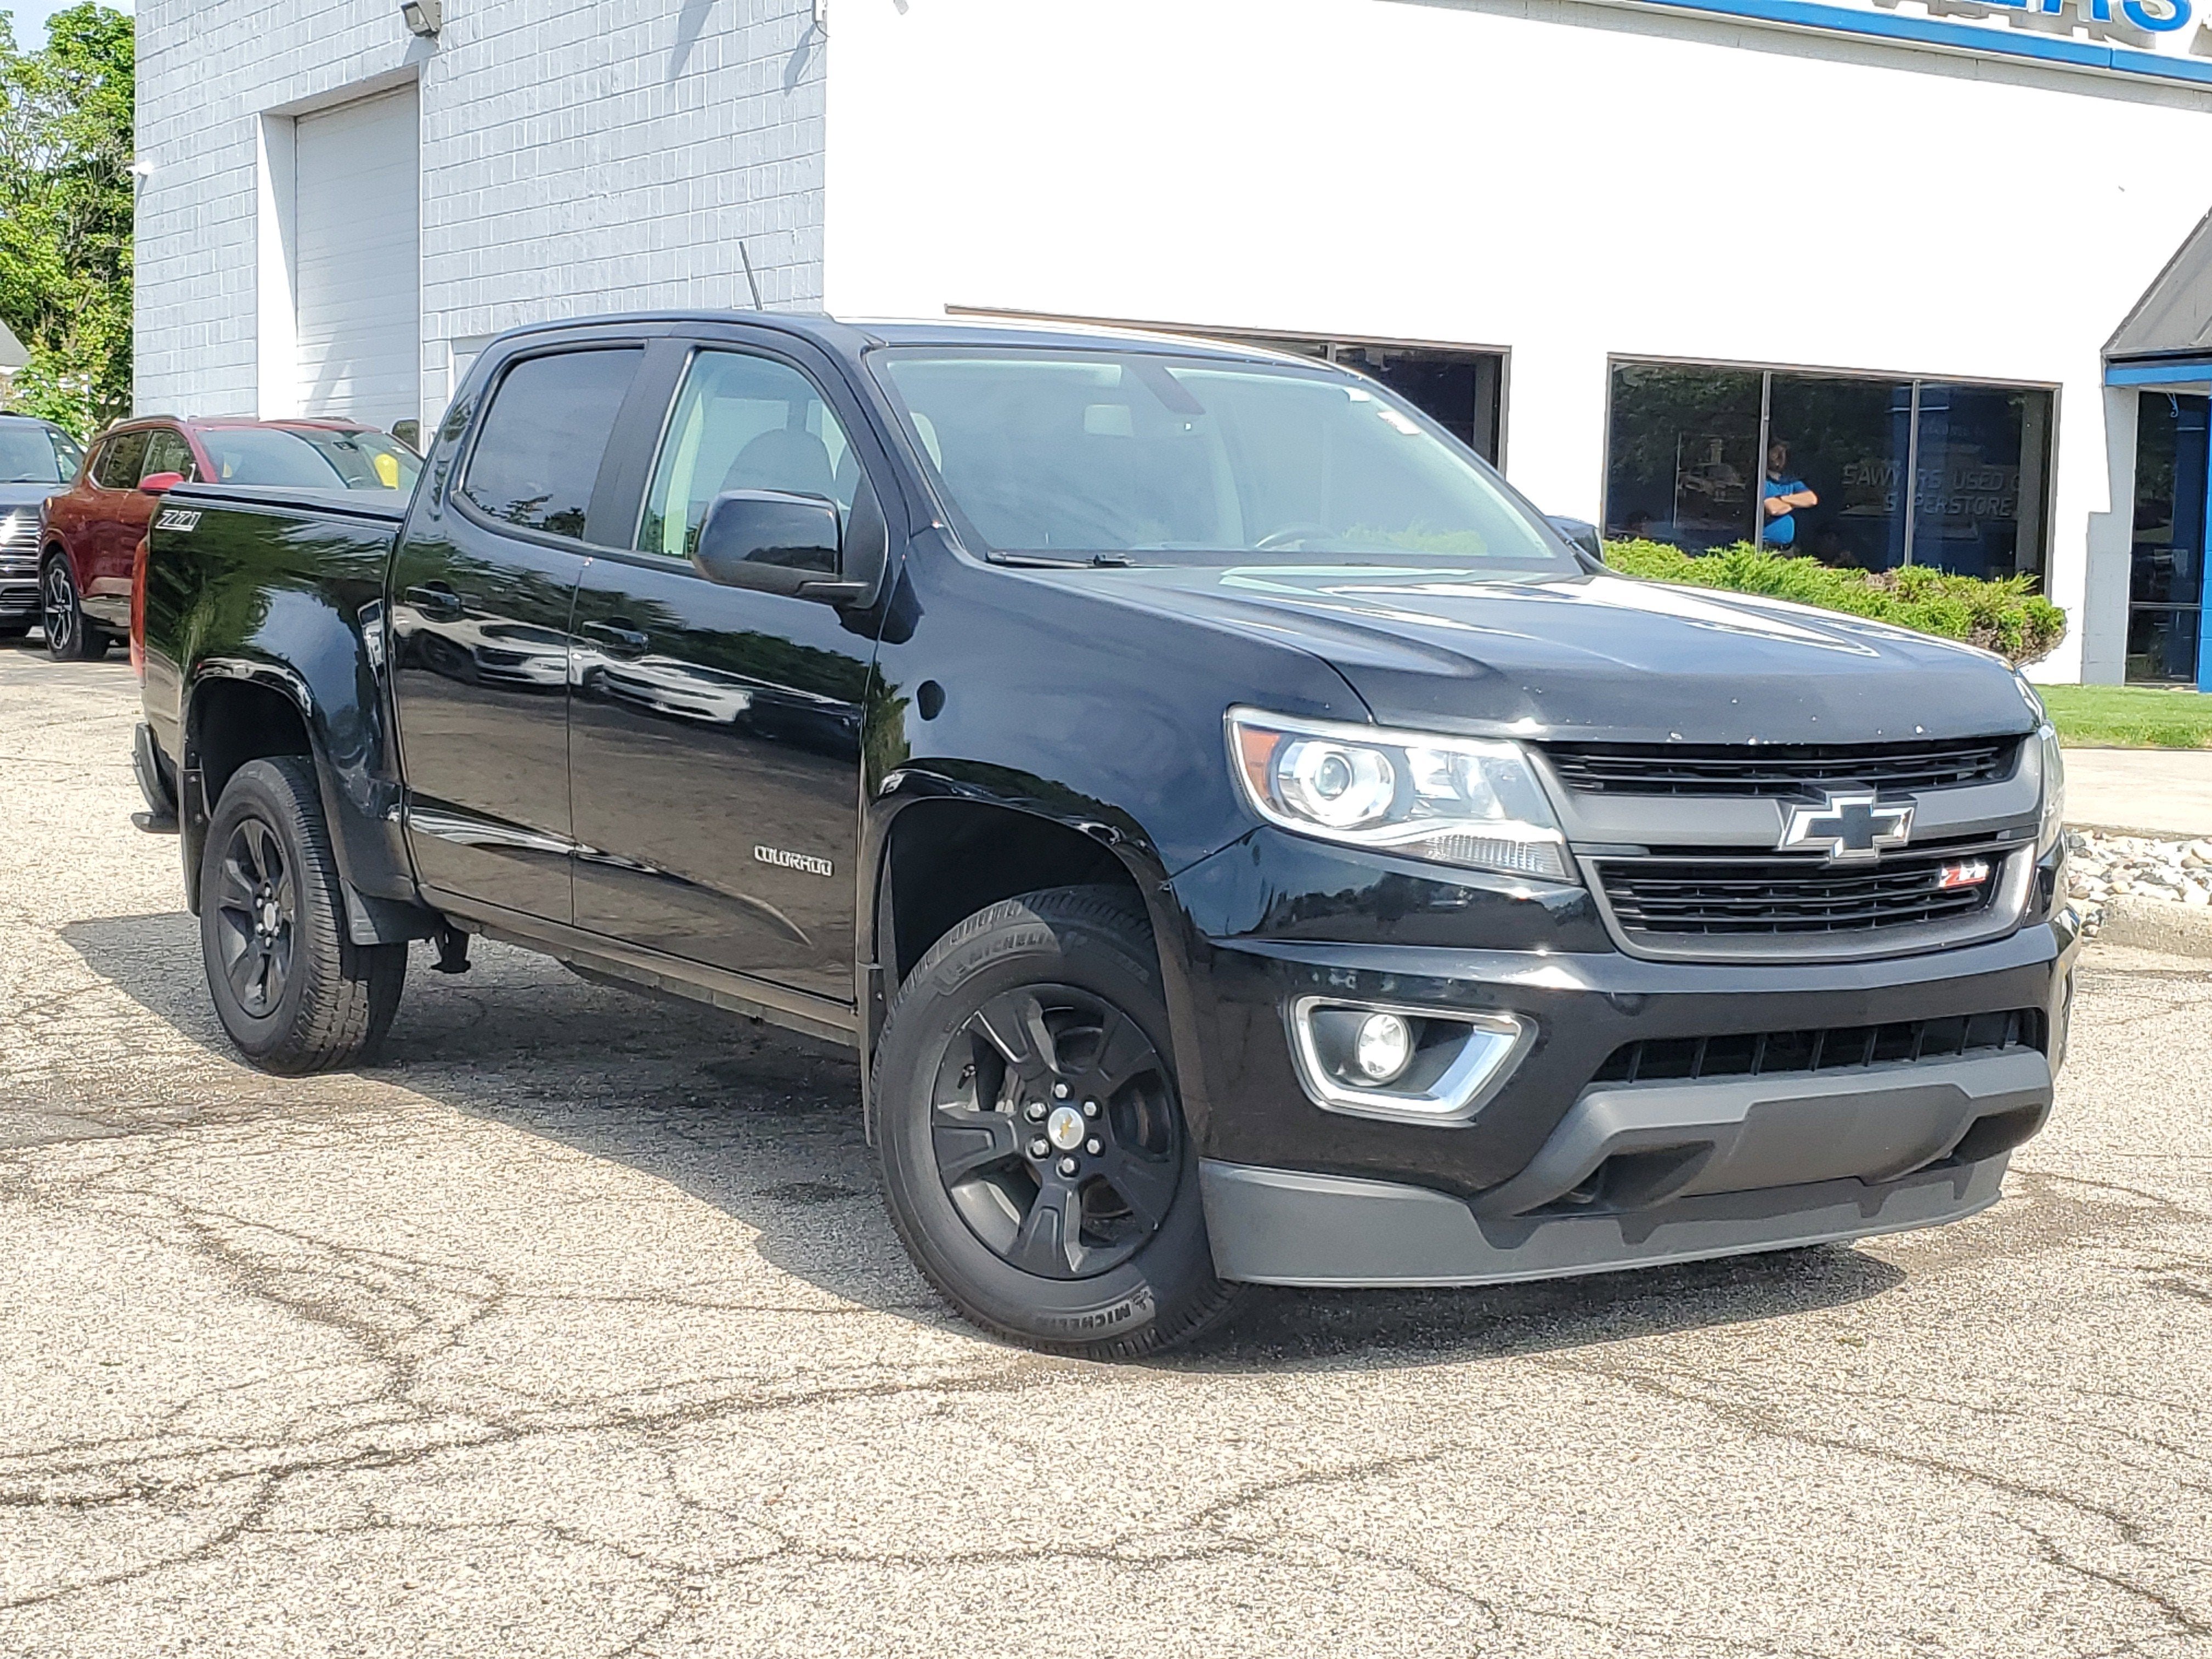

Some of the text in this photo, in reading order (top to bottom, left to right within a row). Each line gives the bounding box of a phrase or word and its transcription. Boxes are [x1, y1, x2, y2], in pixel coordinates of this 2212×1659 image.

[1842, 464, 1943, 488] SAWYRS
[1951, 470, 2004, 490] USED
[1884, 492, 2013, 516] SPERSTORE
[155, 509, 202, 532] Z71
[754, 844, 833, 877] COLORADO
[1938, 862, 1988, 888] Z71
